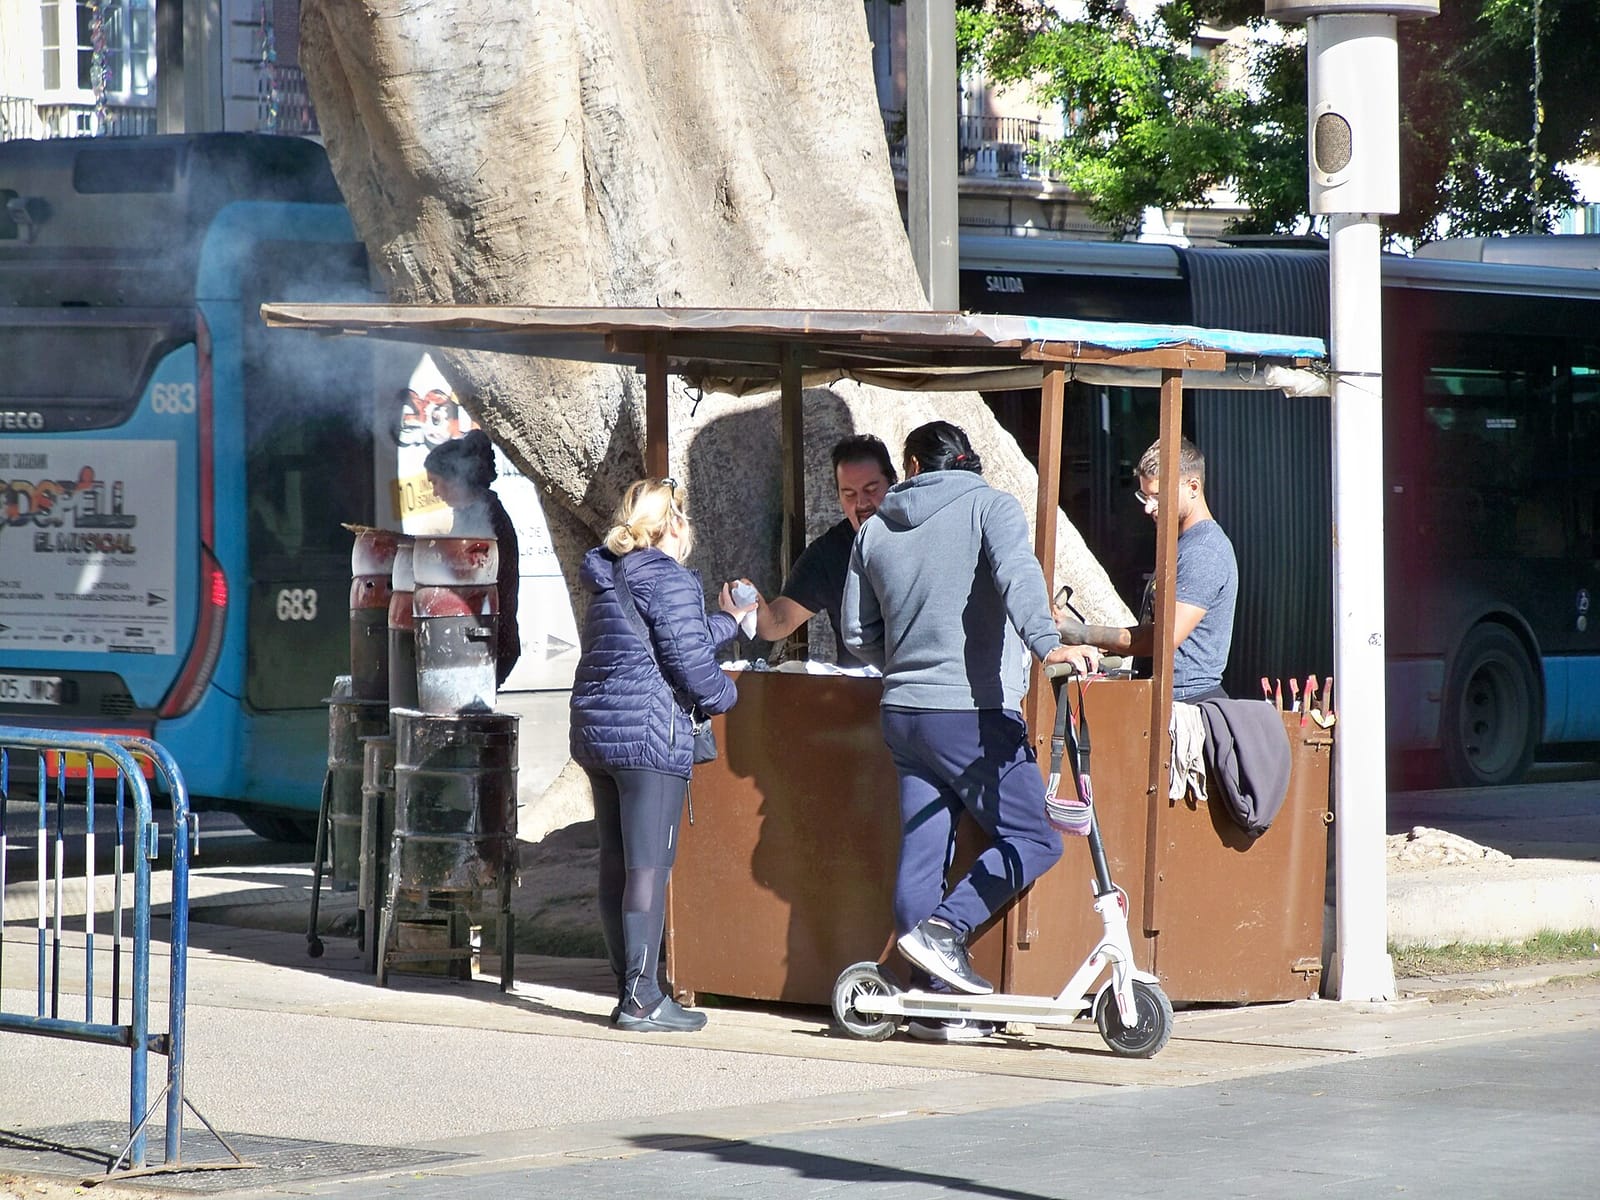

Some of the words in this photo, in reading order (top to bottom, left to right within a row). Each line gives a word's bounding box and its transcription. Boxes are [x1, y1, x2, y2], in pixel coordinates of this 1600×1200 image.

[985, 275, 1025, 293] SALIDA
[152, 383, 196, 414] 683
[277, 588, 318, 620] 683
